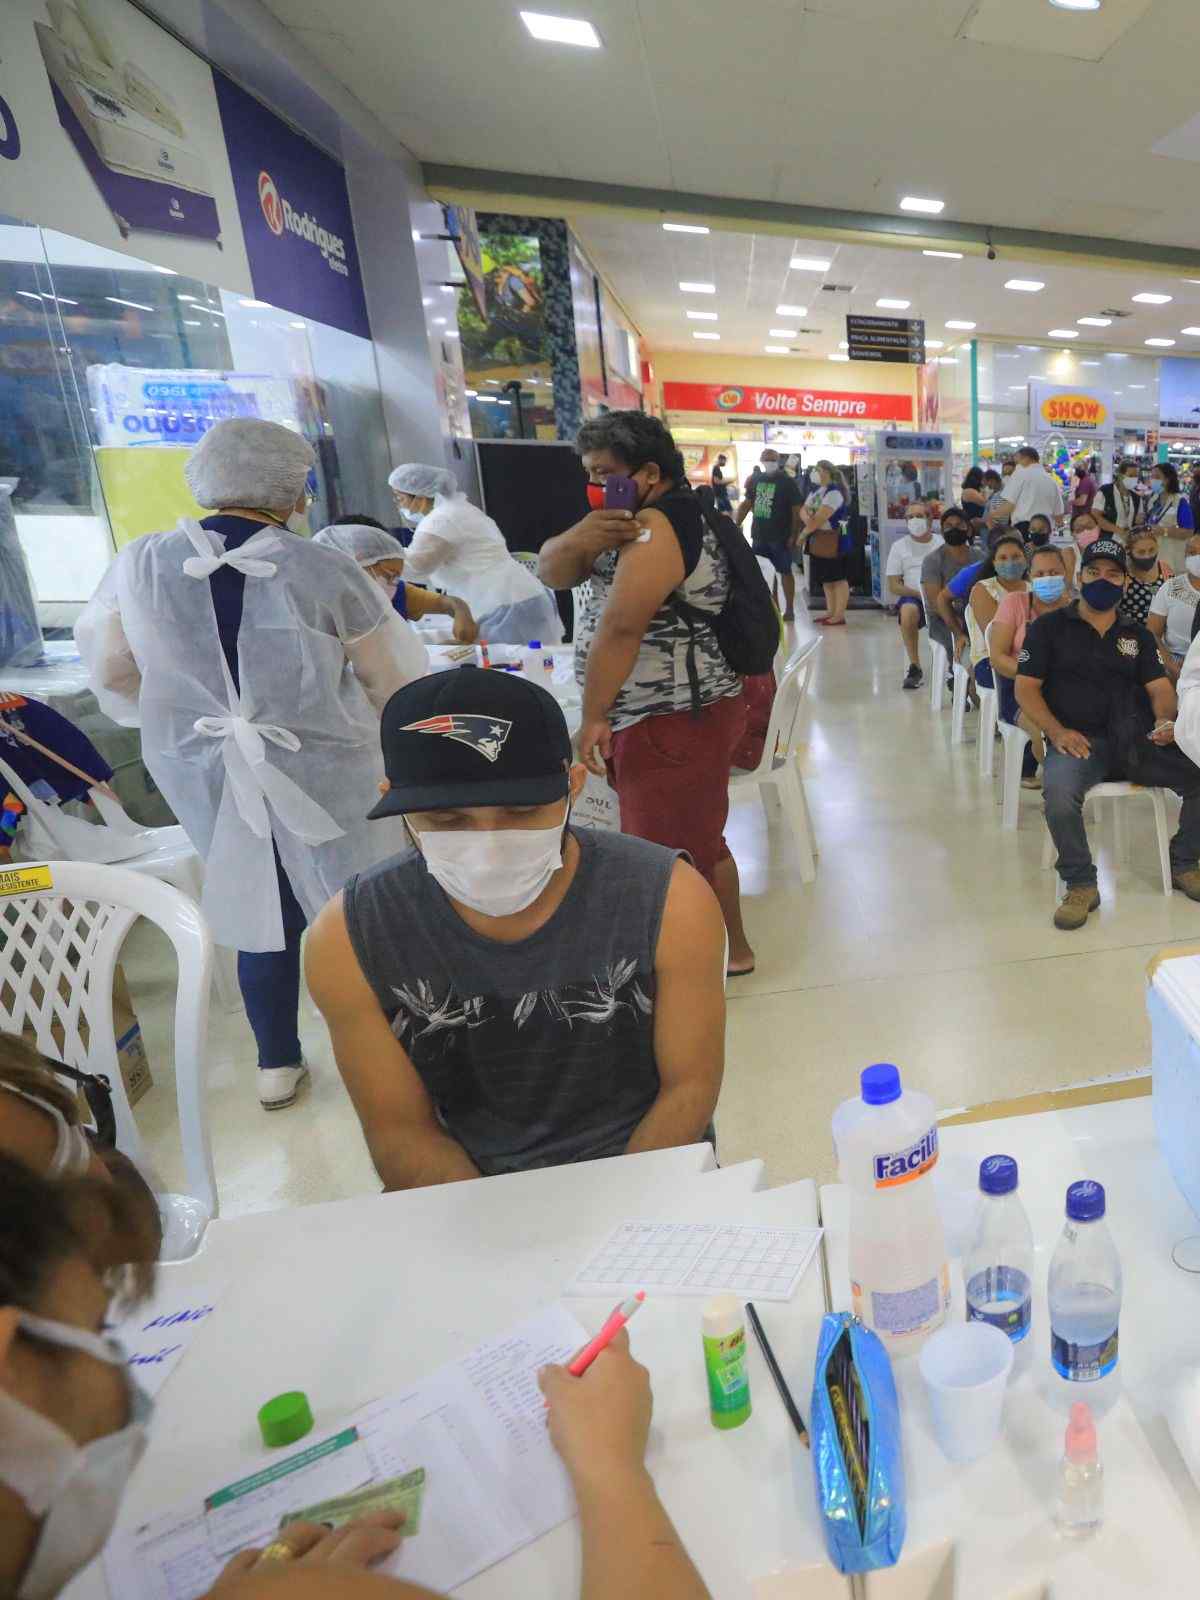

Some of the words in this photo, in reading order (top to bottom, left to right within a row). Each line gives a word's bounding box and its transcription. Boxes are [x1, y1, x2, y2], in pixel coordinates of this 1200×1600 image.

[282, 197, 346, 260] Rodrigues
[754, 392, 798, 412] Volte
[802, 396, 866, 416] Sempre
[1049, 401, 1099, 419] SHOW
[0, 878, 40, 890] ESISTENTE
[876, 1126, 938, 1180] Facili
